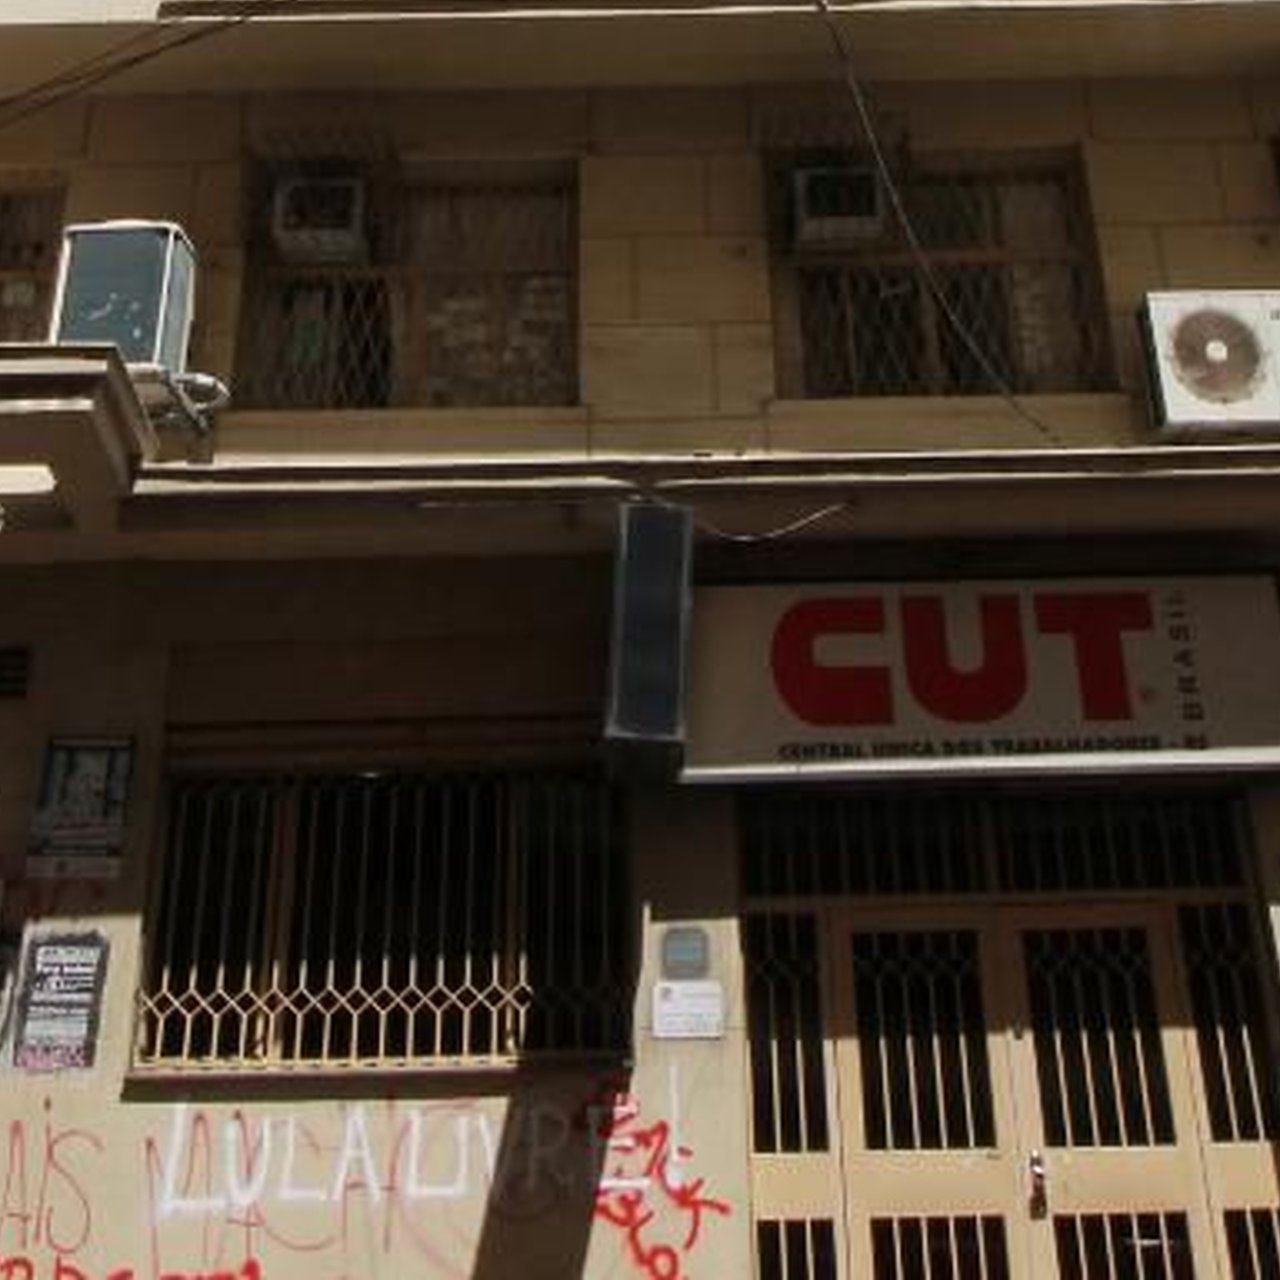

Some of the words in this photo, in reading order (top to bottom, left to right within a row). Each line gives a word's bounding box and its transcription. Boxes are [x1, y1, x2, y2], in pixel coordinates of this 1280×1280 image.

[771, 592, 1154, 726] CUT
[1163, 588, 1206, 722] BRASIL
[778, 741, 863, 761] CENTRAL
[158, 1096, 380, 1212] LULA
